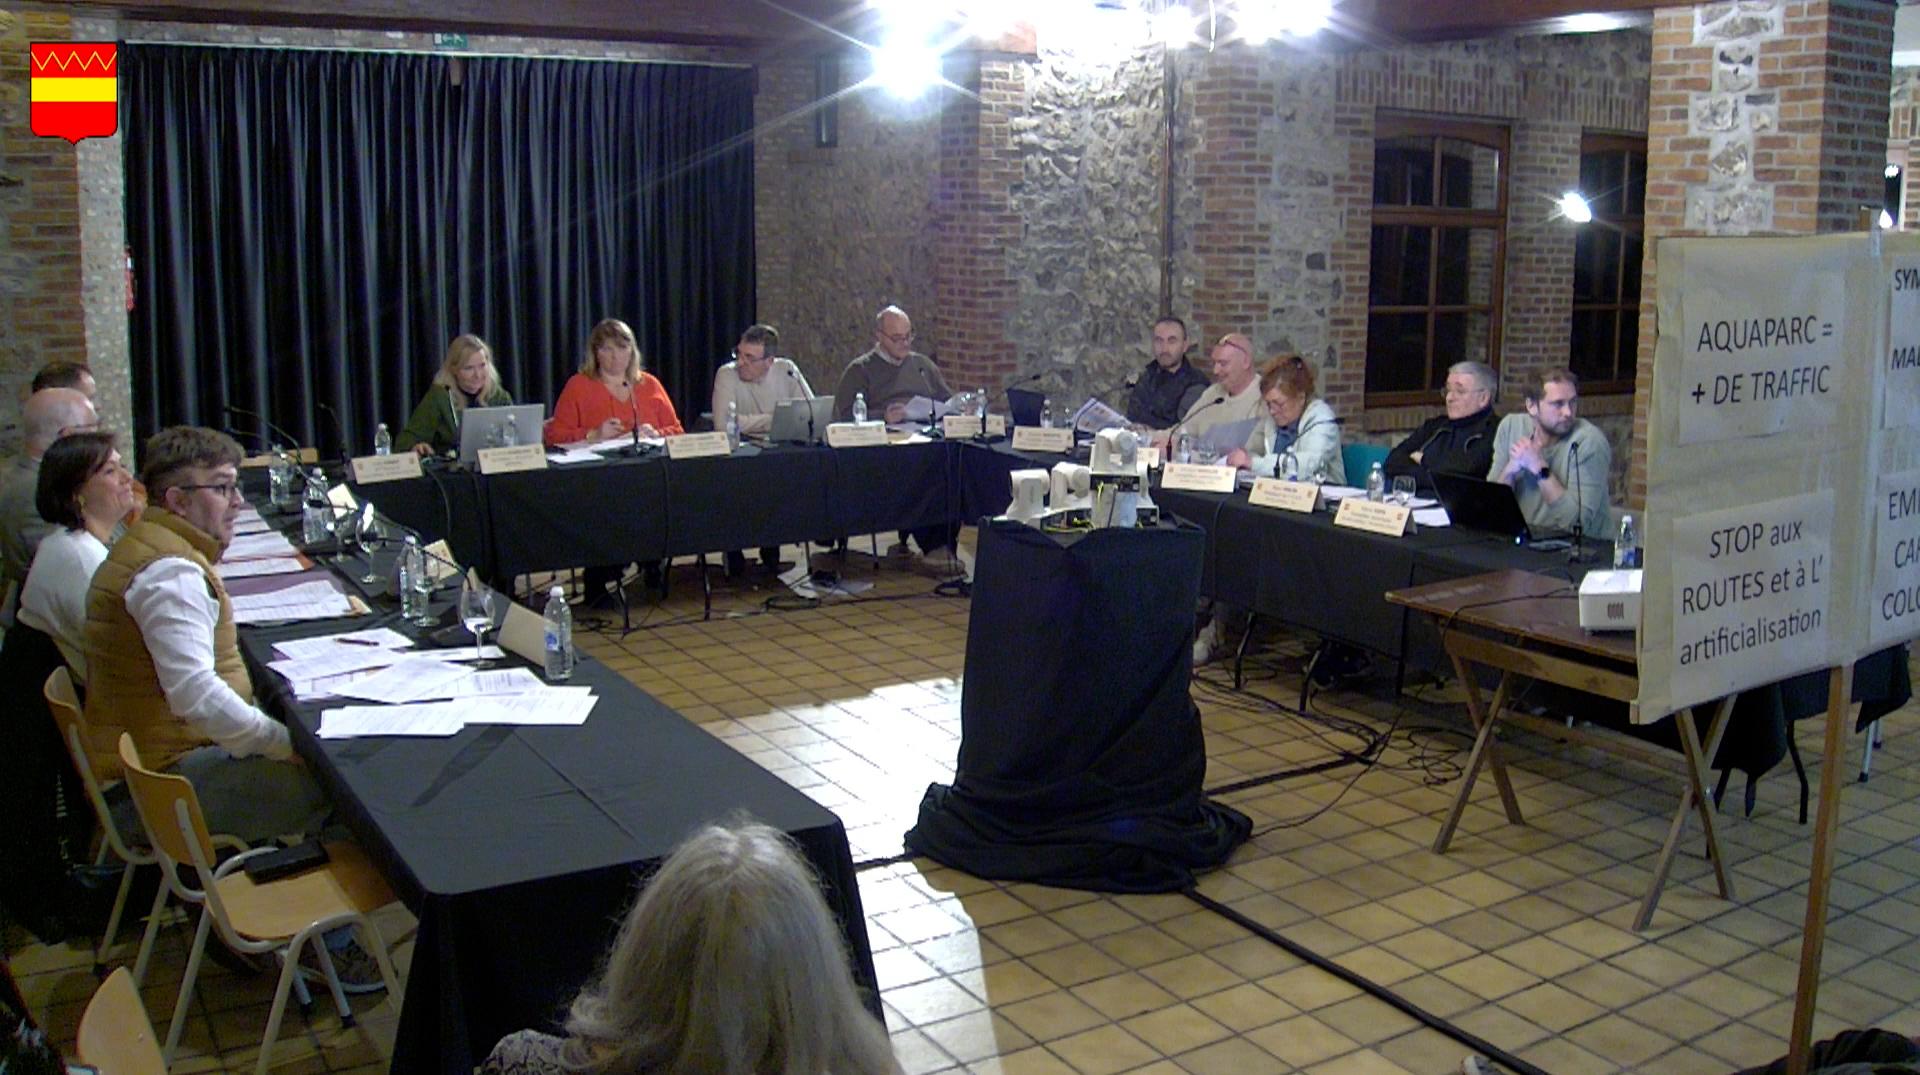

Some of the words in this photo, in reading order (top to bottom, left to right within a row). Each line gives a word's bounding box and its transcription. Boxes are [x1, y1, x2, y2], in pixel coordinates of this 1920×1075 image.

[1697, 315, 1817, 353] AQUAPARC
[1713, 373, 1743, 405] DE
[1751, 365, 1830, 400] TRAFFIC
[1888, 487, 1920, 520] EM
[1709, 522, 1764, 559] STOP
[1770, 520, 1803, 546] aux
[1682, 571, 1764, 616] ROUTES
[1771, 567, 1790, 593] et
[1796, 559, 1805, 588] à
[1680, 608, 1822, 666] artificialisation
